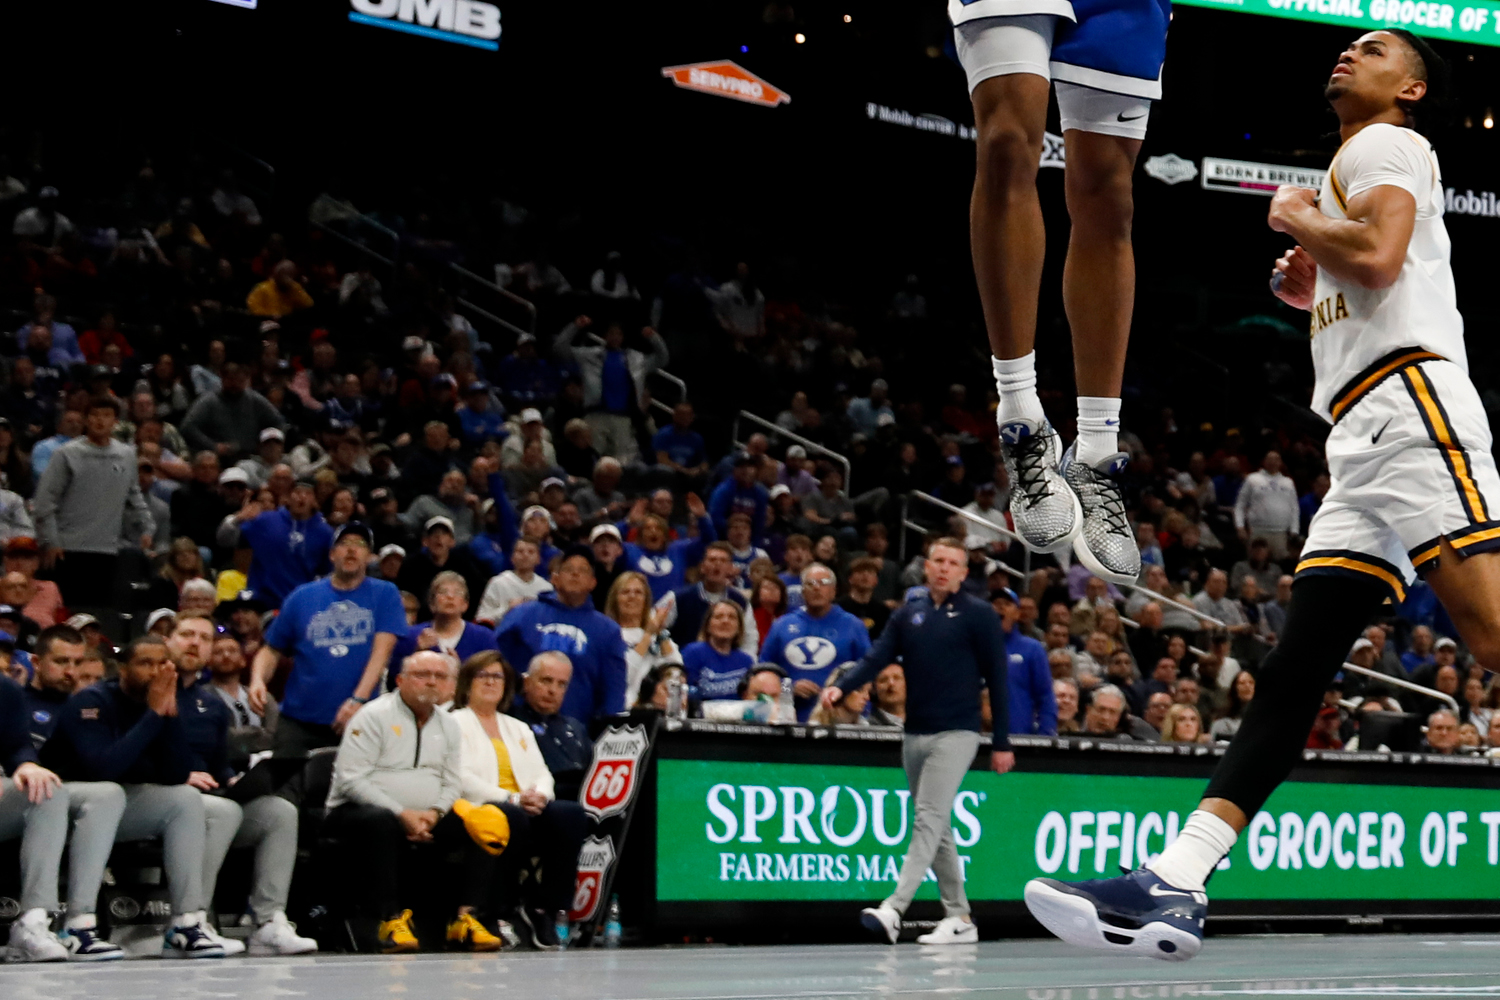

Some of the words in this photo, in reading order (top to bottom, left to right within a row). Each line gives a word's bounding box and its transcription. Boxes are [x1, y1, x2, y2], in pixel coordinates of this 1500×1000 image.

[1458, 6, 1490, 32] OF
[690, 67, 763, 98] SERVPRO
[1214, 164, 1253, 179] BORN
[601, 739, 640, 756] PHILLIPS
[589, 764, 630, 800] 66
[705, 783, 982, 847] SPROUS
[1248, 811, 1405, 870] GROCER
[1420, 811, 1468, 867] OF
[719, 853, 850, 882] FARMERS
[573, 876, 597, 912] 6
